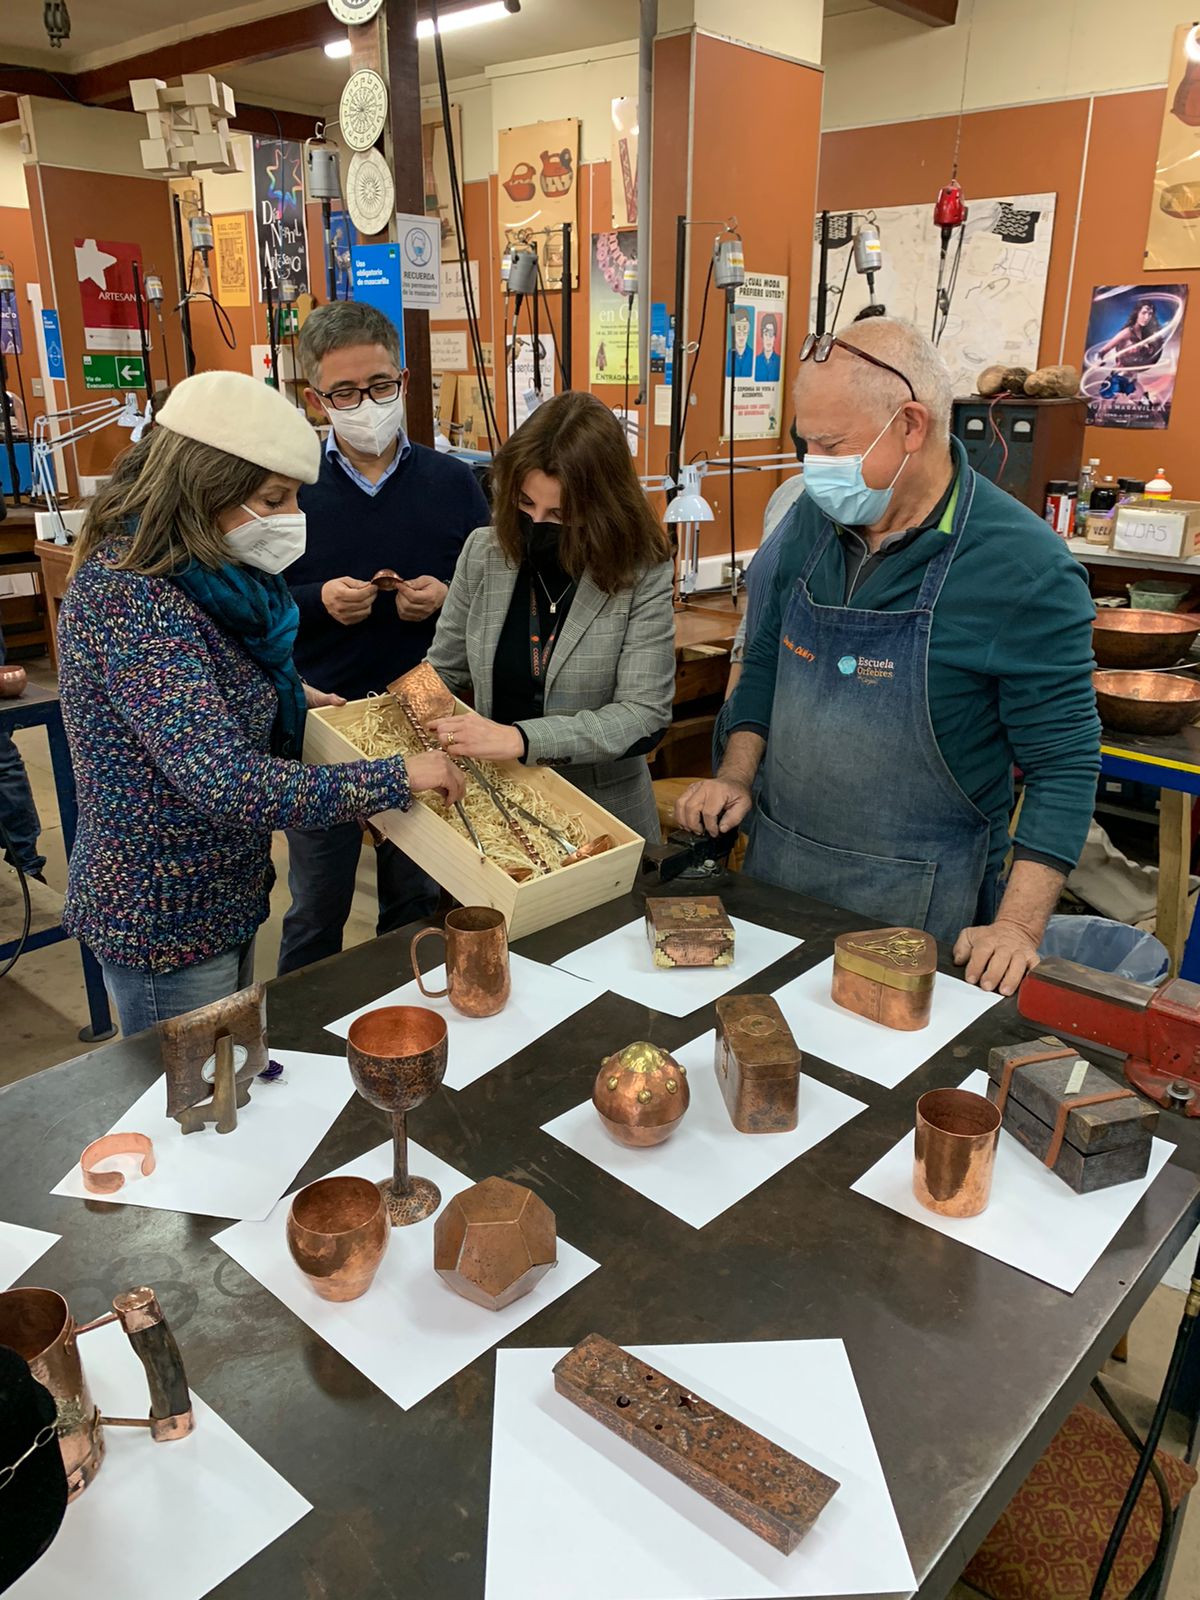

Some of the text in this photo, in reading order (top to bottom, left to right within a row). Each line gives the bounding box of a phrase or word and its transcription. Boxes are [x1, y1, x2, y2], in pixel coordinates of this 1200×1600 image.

[404, 272, 435, 280] RECUERDA
[745, 278, 780, 288] ¿CUAL MODA
[98, 292, 146, 302] ARTESANA
[739, 288, 784, 300] PREFIERE USTED?
[600, 308, 615, 322] en
[858, 656, 894, 670] Escuela
[857, 666, 894, 678] Orfebres
